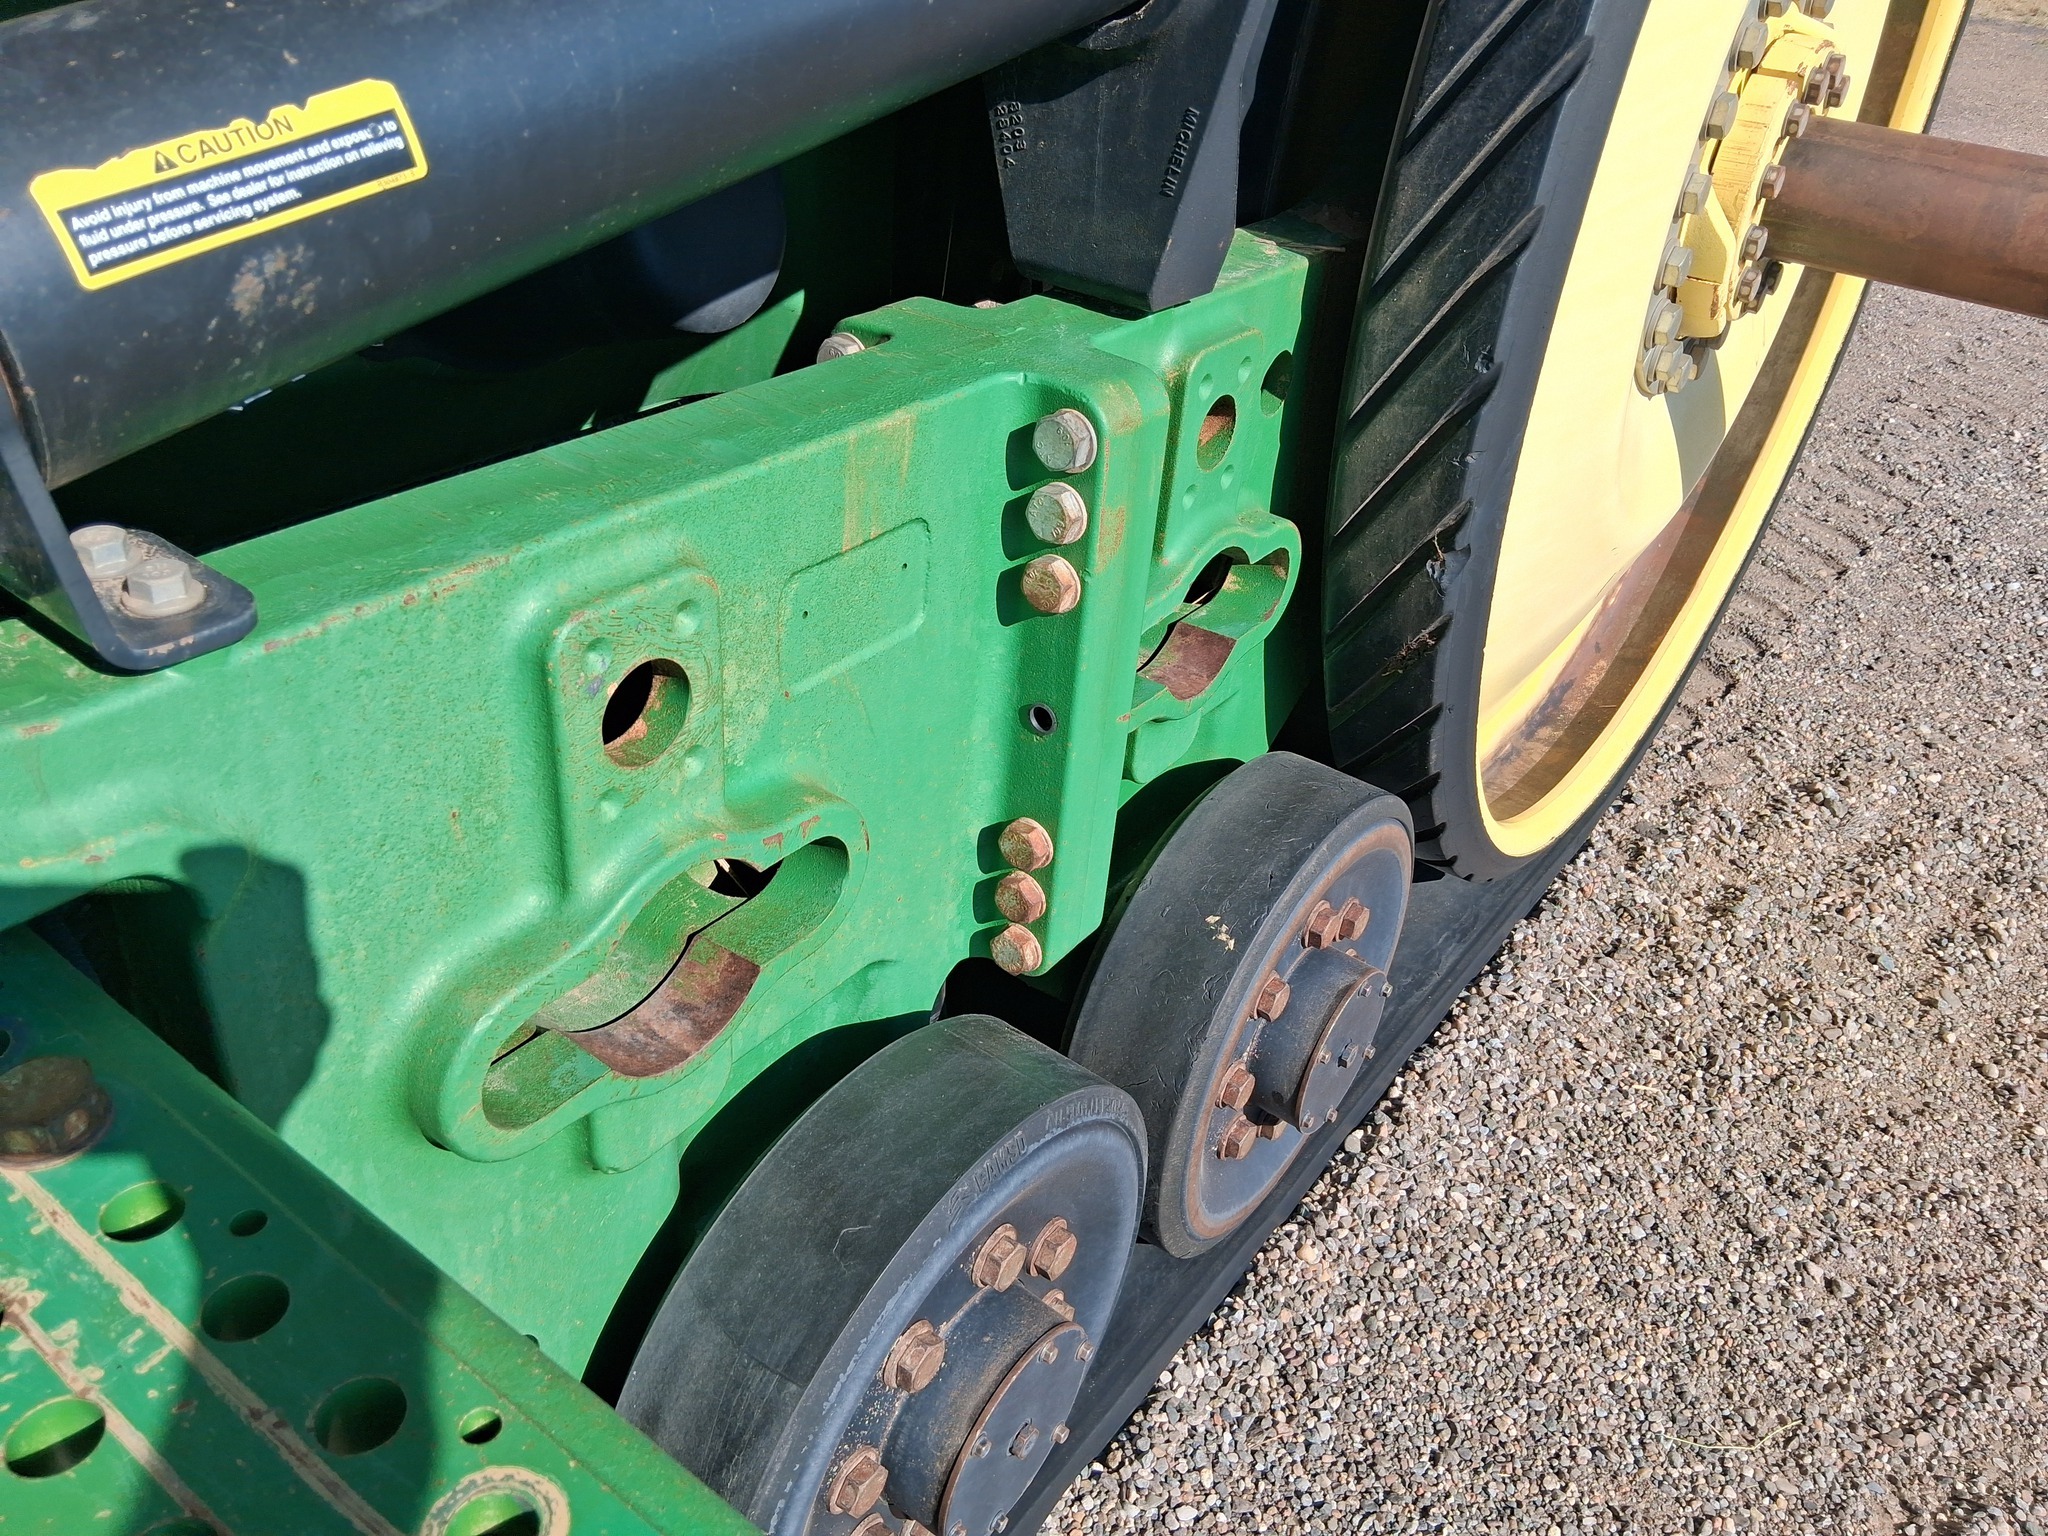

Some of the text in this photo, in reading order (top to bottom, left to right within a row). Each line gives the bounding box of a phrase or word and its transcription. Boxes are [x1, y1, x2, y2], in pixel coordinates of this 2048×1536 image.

[71, 120, 398, 231] Avoid injury from machine movement and exposu to
[176, 115, 294, 163] CAUTION
[1160, 106, 1200, 197] MICHELIN
[78, 135, 405, 248] fluid under pressure. See dealer for instruction on relieving
[88, 187, 303, 269] pressure before servicing system.
